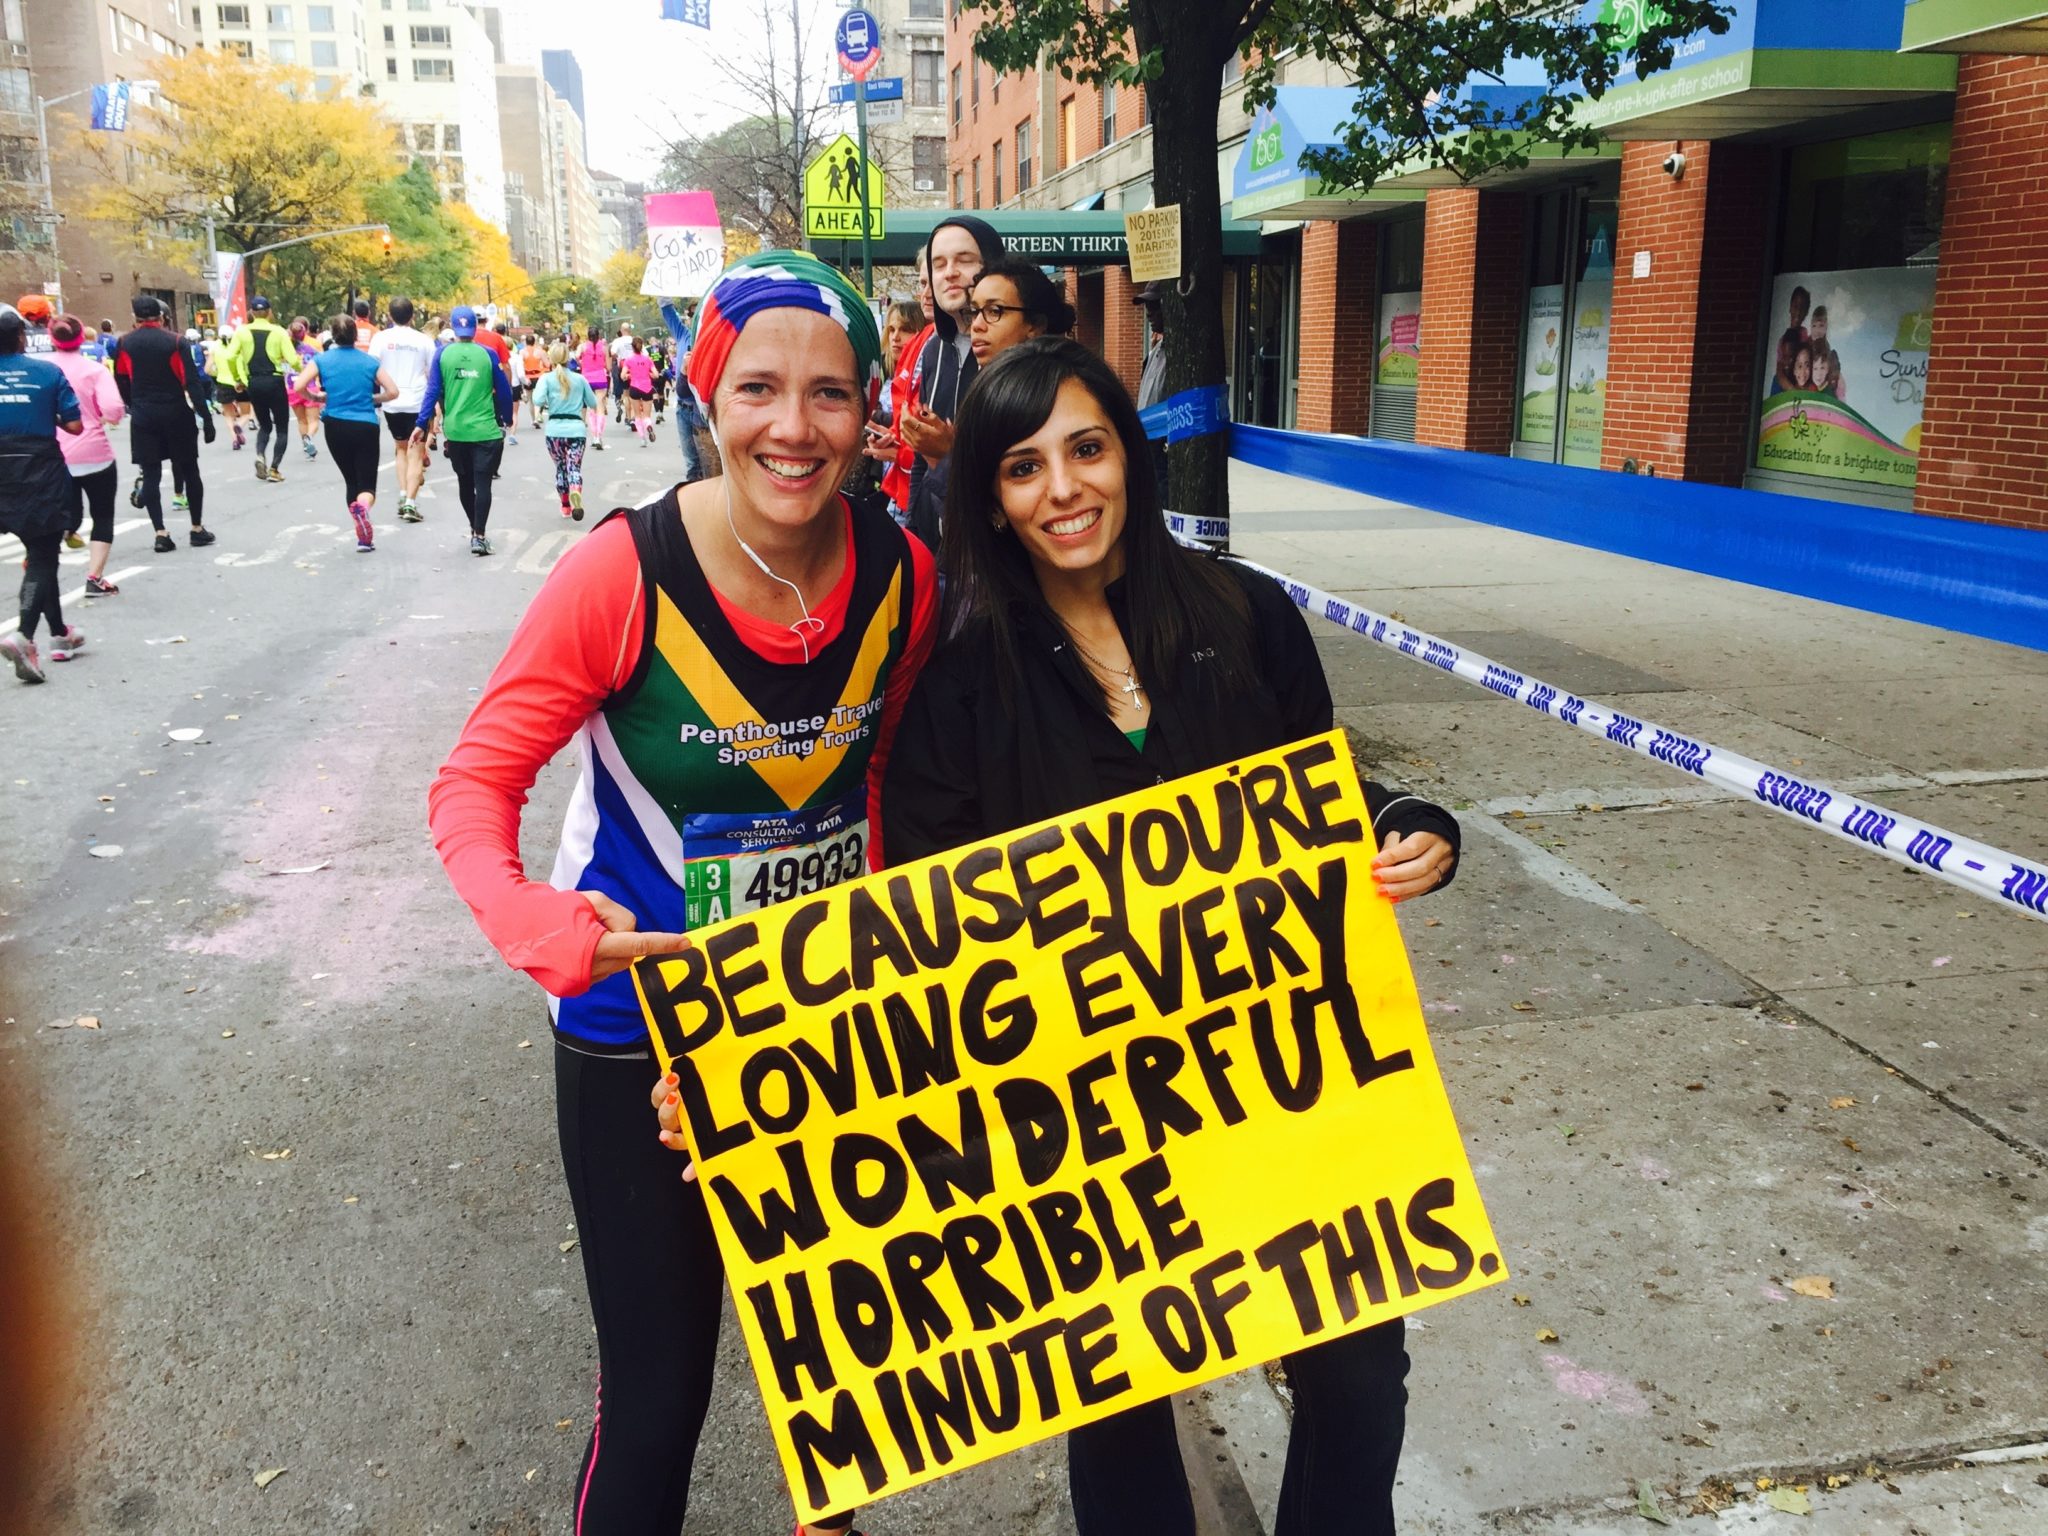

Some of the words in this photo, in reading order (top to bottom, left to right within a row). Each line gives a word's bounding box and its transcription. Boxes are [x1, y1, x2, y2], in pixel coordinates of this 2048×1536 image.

[1701, 61, 1744, 90] school
[1128, 215, 1146, 232] NO
[1148, 208, 1179, 229] PARKING
[1140, 229, 1161, 242] 2015
[1161, 226, 1175, 238] NYC
[1135, 239, 1178, 254] MARATHON
[1763, 443, 1814, 463] Education
[1815, 450, 1832, 466] for
[1834, 454, 1841, 466] a
[1844, 451, 1891, 474] brighter
[1324, 599, 1350, 628] CROSS
[1352, 611, 1370, 636] NOT
[1371, 619, 1386, 642] DO
[1399, 630, 1421, 656] LINE
[1422, 639, 1460, 673] POLICE
[1480, 664, 1524, 699] CROSS
[1526, 682, 1556, 714] NOT
[1559, 695, 1585, 726] DO
[680, 715, 825, 745] Penthouse
[831, 690, 885, 726] Travel
[1606, 713, 1643, 749] LINE
[717, 738, 815, 767] Sporting
[821, 724, 870, 749] Tours
[1648, 728, 1712, 776] POLICE
[1754, 770, 1833, 823] CROSS
[726, 821, 806, 839] CONSULTANCY
[752, 818, 789, 829] TATA
[815, 814, 843, 833] TATA
[1841, 804, 1896, 850] NOT
[741, 835, 794, 849] SERVICES
[1906, 829, 1953, 872] DO
[706, 863, 721, 891] 3
[744, 832, 863, 909] 49933
[637, 825, 1088, 1058] BECAUSE
[1071, 741, 1365, 932] YOU'RE
[707, 896, 725, 925] A
[671, 958, 1037, 1161] LOVING
[1061, 860, 1348, 1037] EVERY
[709, 985, 1415, 1265] WONDERFUL
[745, 1154, 1203, 1403] HORRIBLE
[787, 1303, 1133, 1511] MINUTE
[1142, 1248, 1253, 1374] OF
[1253, 1178, 1500, 1336] THIS.
